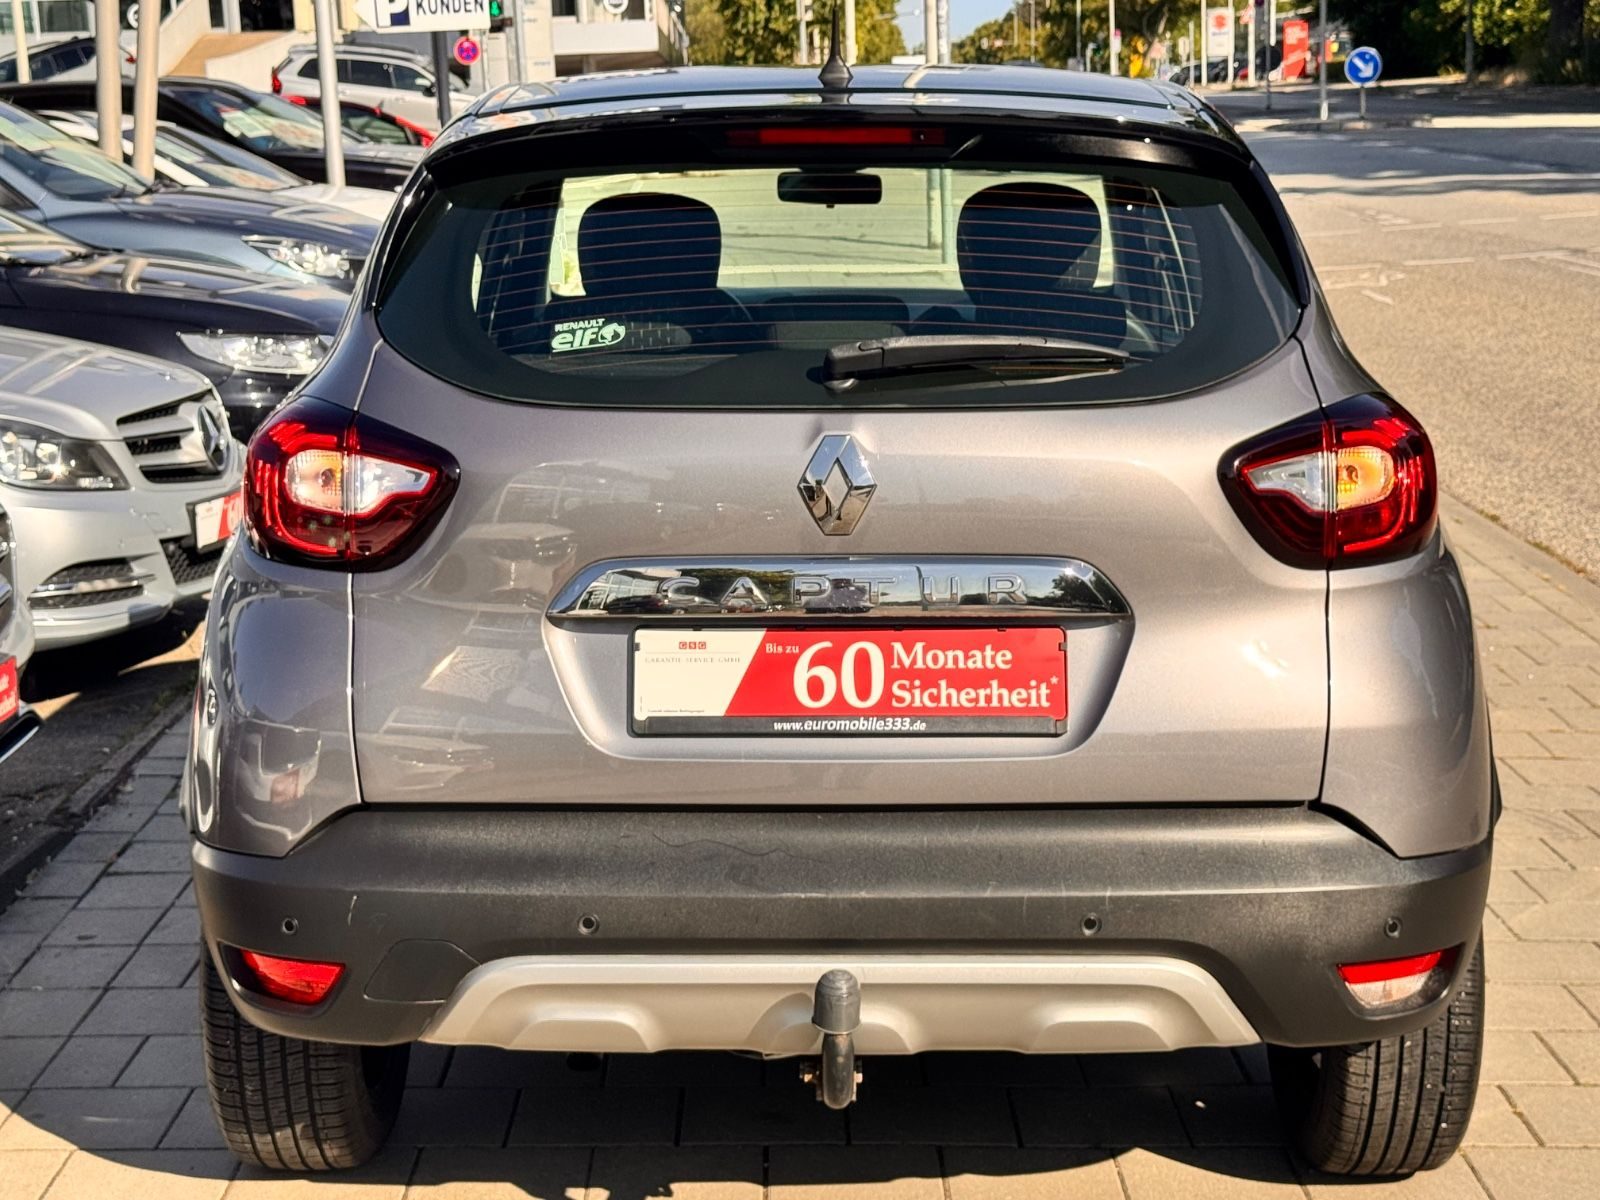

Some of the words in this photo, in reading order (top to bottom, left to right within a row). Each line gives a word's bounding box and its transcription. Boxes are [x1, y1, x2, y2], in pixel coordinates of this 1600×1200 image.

[416, 0, 484, 15] KUNDEN
[554, 318, 606, 332] RENAULT
[551, 328, 599, 349] elf
[656, 574, 1028, 607] CAPTUR
[765, 643, 783, 654] Bis
[785, 645, 800, 654] zu
[891, 641, 1013, 669] Monate
[793, 640, 885, 709] 60
[773, 716, 927, 731] www.euromobile333.de
